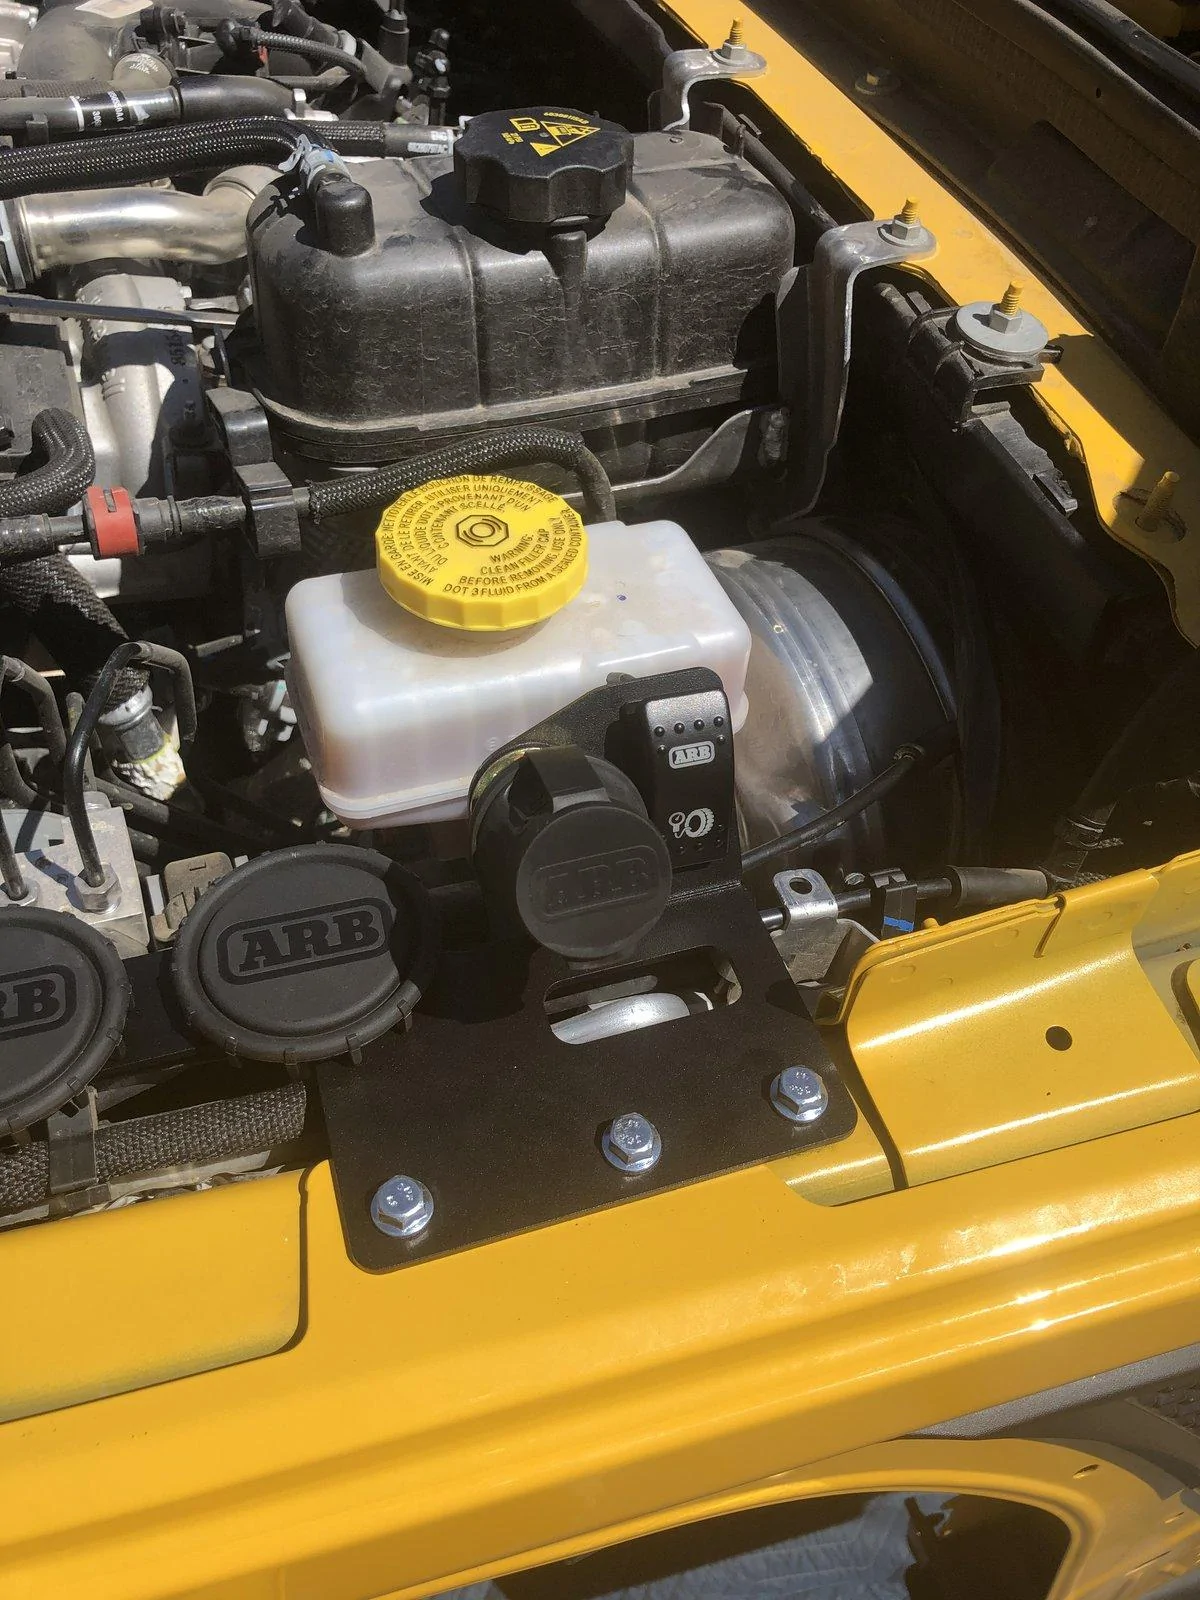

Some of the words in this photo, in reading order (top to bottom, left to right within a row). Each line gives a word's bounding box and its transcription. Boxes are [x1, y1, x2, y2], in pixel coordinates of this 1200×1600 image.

[420, 475, 470, 493] BOUCHON
[473, 475, 487, 483] DE
[408, 490, 419, 501] LE
[425, 484, 470, 501] UTILISER
[473, 485, 544, 505] UNIQUEMENT
[490, 475, 559, 502] REMPLISSAGE
[438, 493, 505, 507] PROVENANT
[507, 498, 531, 511] D'UN
[382, 496, 409, 532] NETTOYER
[417, 509, 433, 524] DOT
[430, 505, 459, 549] CONTENANT
[549, 517, 566, 534] ONLY
[560, 507, 582, 547] CONTAINER
[398, 530, 411, 540] LE
[400, 540, 415, 551] DE
[480, 562, 520, 575] CLEAN
[518, 544, 545, 568] FILLER
[538, 529, 549, 543] CAP
[552, 537, 566, 551] USE
[397, 560, 412, 571] EN
[407, 553, 438, 574] AVANT
[431, 553, 449, 566] DU
[553, 549, 579, 573] SEALED
[407, 569, 434, 586] MISE
[460, 575, 508, 586] BEFORE
[516, 576, 546, 592] FROM
[545, 571, 556, 581] A
[444, 583, 469, 595] DOT
[471, 588, 479, 597] 3
[481, 585, 515, 597] FLUID
[673, 744, 711, 765] ARB
[546, 861, 650, 912] ARB
[239, 910, 380, 972] ARB
